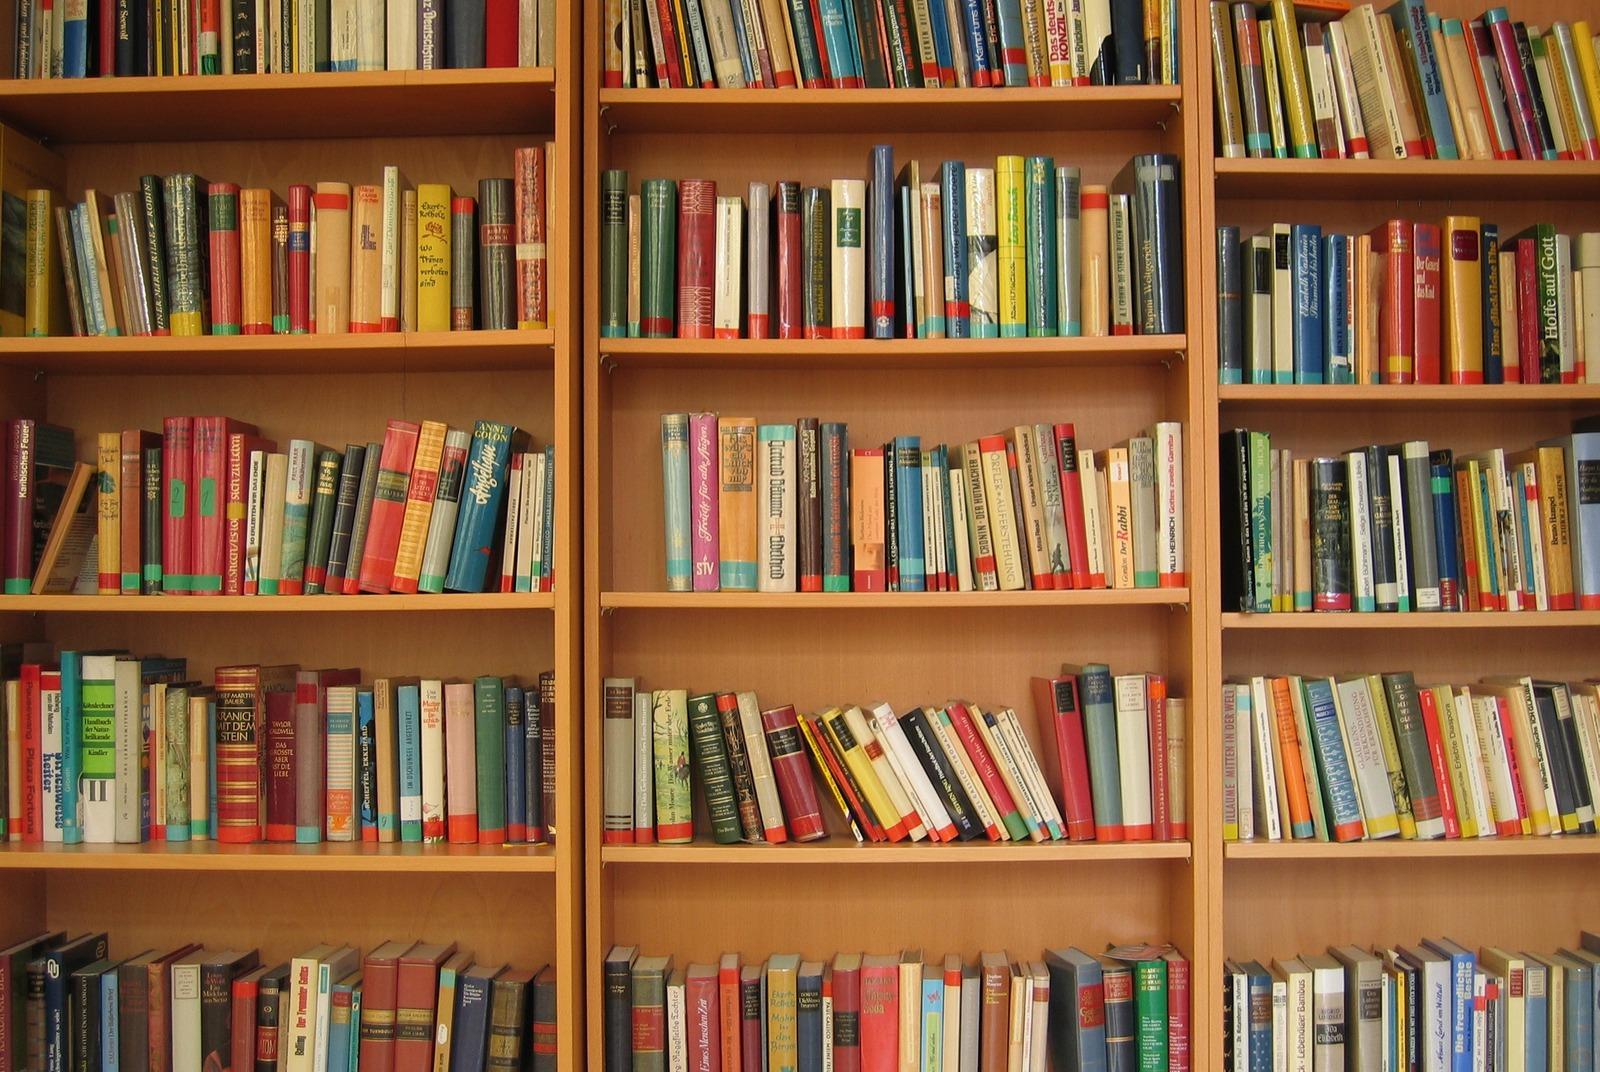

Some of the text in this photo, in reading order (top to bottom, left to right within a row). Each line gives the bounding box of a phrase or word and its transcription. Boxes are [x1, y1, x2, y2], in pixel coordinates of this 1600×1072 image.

[119, 10, 129, 41] Seewolf
[888, 5, 903, 71] Renate Kampmann
[971, 10, 985, 61] Kampf ums
[987, 25, 998, 43] Eric
[1057, 14, 1069, 61] KONZIL
[1049, 38, 1060, 62] Das
[144, 184, 154, 217] RODIN
[148, 231, 159, 263] RILKE
[418, 244, 433, 252] Wo
[1486, 241, 1498, 264] Ehe
[419, 264, 449, 276] verboten
[1140, 238, 1154, 293] Weltgericht
[1299, 277, 1311, 318] Elisabeth
[1540, 235, 1559, 339] Hoffe auf Gott
[474, 430, 509, 444] GOLON
[479, 422, 506, 436] ANNE
[696, 424, 712, 463] Augen
[17, 424, 30, 499] Karibisches Feuer
[1240, 446, 1248, 463] werde
[468, 441, 500, 505] Angélique
[250, 491, 258, 504] WIR
[967, 458, 989, 555] CRONIN DER HUTMACHER
[1021, 432, 1043, 552] Miss Read Unser kleines Schicksal
[1044, 479, 1054, 507] Daphne
[1166, 433, 1177, 554] HEINRICH Gottes zweite Garnitur
[249, 504, 258, 537] ERLEBTEN
[697, 500, 713, 542] Freude
[1115, 504, 1129, 556] Der Rabbi
[1356, 479, 1369, 576] Bühlmann Selige Schwester
[1547, 495, 1559, 545] Bruno Hampel
[996, 497, 1016, 584] AUFERSTEHUNG
[1244, 546, 1252, 563] Komm
[696, 562, 715, 576] STV
[84, 718, 112, 726] Handbuch
[664, 696, 672, 713] Erde
[220, 731, 248, 742] STEIN
[232, 721, 256, 731] DEM
[960, 715, 977, 742] Mostar
[1223, 689, 1235, 778] MITTEN IN DER WELT
[1444, 703, 1463, 769] Erlebte Diaspora
[25, 682, 36, 835] Pausewang Plaza Fortuna
[361, 725, 370, 767] EKKEHARD
[1529, 711, 1551, 791] Wilhelm Sandfuchs ICH
[43, 753, 54, 793] heiter
[984, 763, 997, 778] Die
[297, 966, 309, 985] Gottes
[1463, 961, 1474, 1000] Bestie
[295, 1017, 306, 1029] Der
[824, 1001, 832, 1015] PAUL
[1295, 979, 1307, 1058] Lebendiger Bambus
[1454, 961, 1466, 1053] Die freundliche
[697, 999, 710, 1072] Eines Menschen Zeit
[824, 1015, 832, 1039] GALLICO
[294, 1036, 306, 1056] Balling
